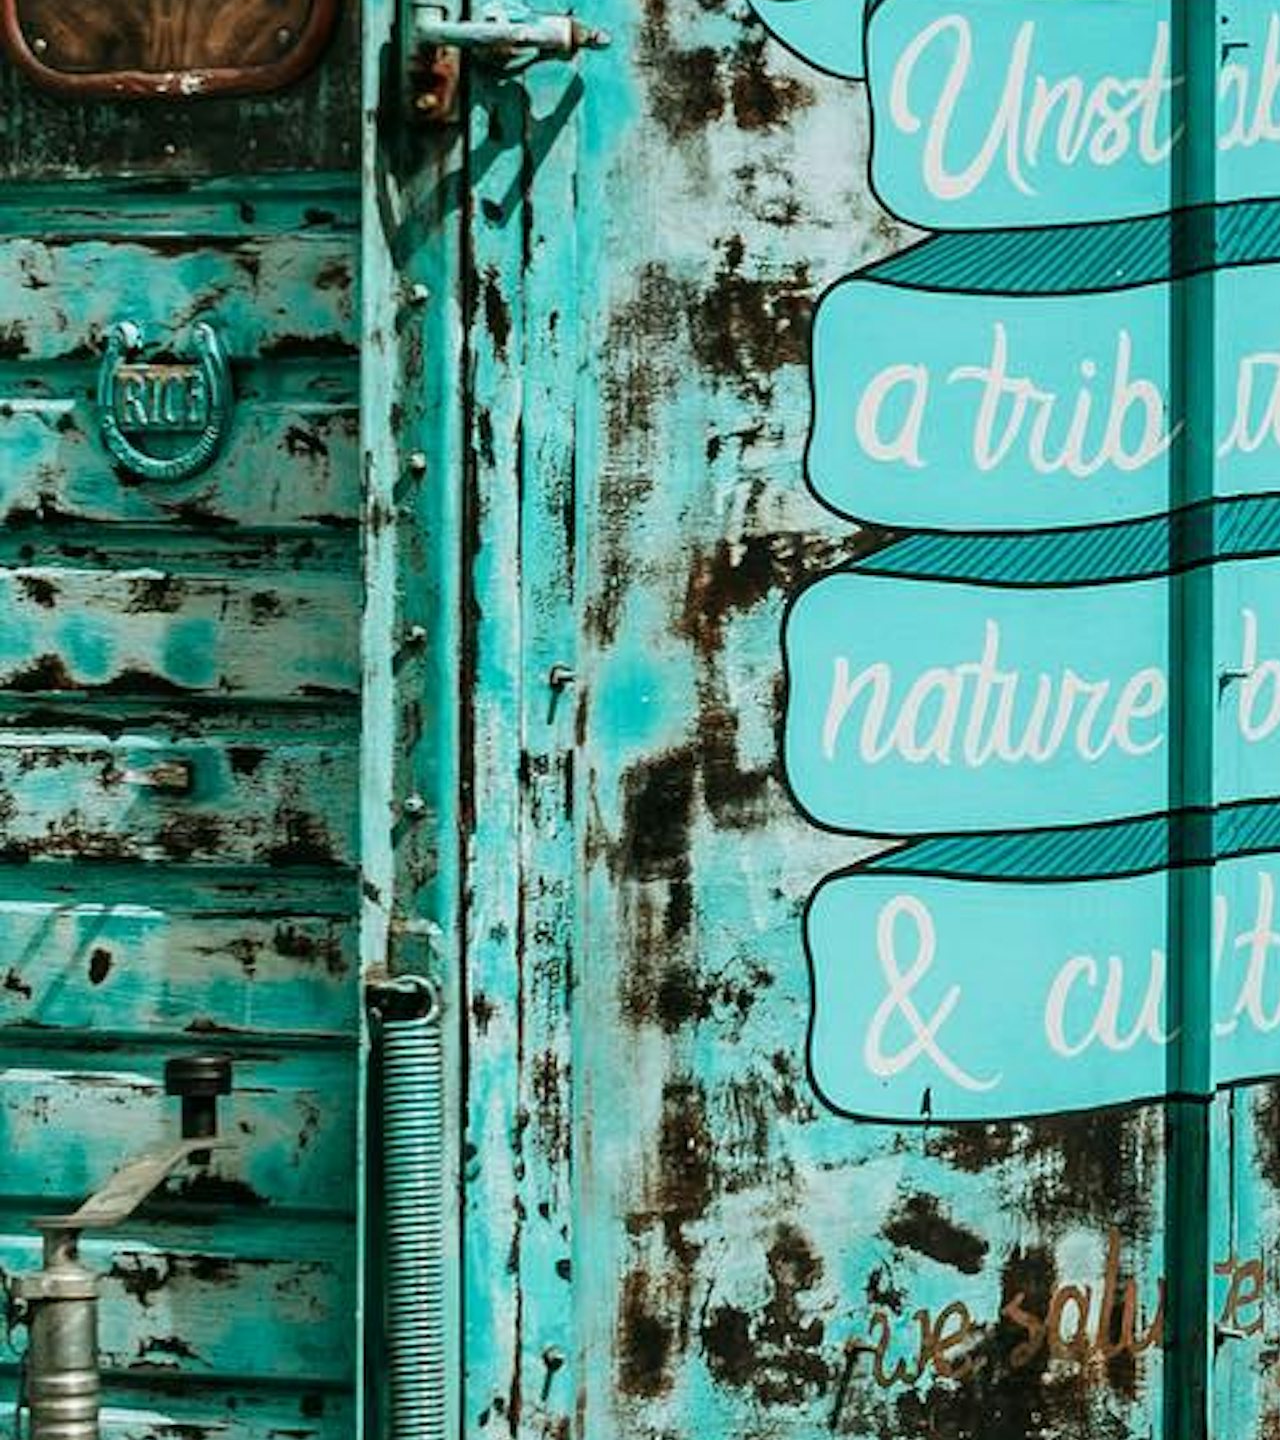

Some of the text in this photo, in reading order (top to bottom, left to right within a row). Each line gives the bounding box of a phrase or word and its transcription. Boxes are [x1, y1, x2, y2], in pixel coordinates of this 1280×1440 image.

[856, 360, 926, 470] a
[823, 621, 1169, 766] nature
[868, 895, 1002, 1090] &
